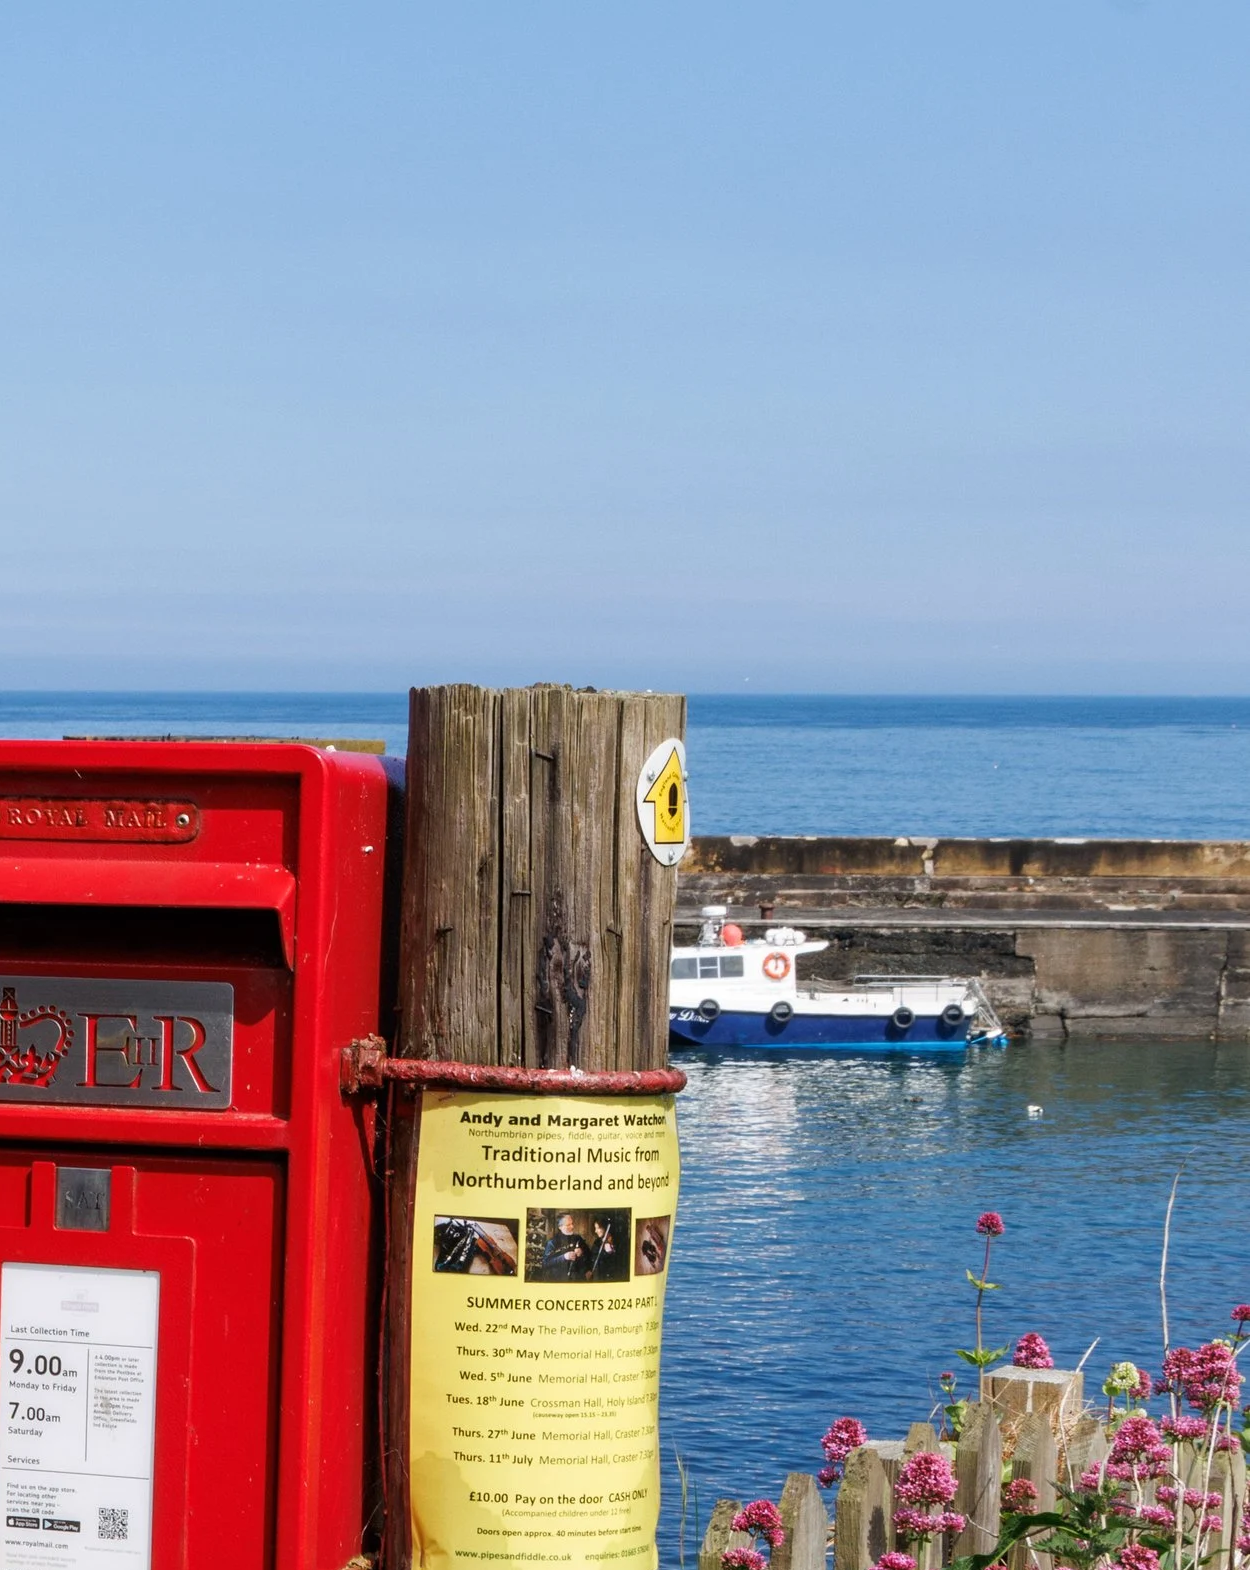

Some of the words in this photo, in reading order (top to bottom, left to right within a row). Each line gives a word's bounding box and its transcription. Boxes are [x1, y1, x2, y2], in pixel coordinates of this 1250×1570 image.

[7, 808, 89, 827] ROYAL
[105, 810, 166, 828] MAIL
[460, 1111, 503, 1128] Andy
[508, 1113, 541, 1126] and
[547, 1115, 619, 1129] Margaret
[468, 1129, 534, 1139] Northumbrian
[537, 1131, 565, 1141] pipes,
[568, 1130, 595, 1140] fiddle,
[597, 1131, 623, 1142] guitar,
[625, 1131, 643, 1139] voice
[643, 1131, 655, 1139] and
[482, 1145, 581, 1163] Traditional
[587, 1147, 631, 1163] Music
[635, 1147, 660, 1162] from
[452, 1171, 603, 1190] Northumberland
[608, 1173, 634, 1190] and
[638, 1170, 670, 1193] beyond
[65, 1190, 105, 1209] SAT
[467, 1296, 531, 1310] SUMMER
[536, 1299, 604, 1311] CONCERTS
[607, 1298, 633, 1310] 2024
[635, 1296, 654, 1309] PART
[10, 1324, 27, 1334] Last
[30, 1326, 68, 1336] Collection
[70, 1328, 90, 1338] Time
[455, 1321, 482, 1332] Wed.
[485, 1321, 508, 1333] 22nd
[511, 1325, 535, 1336] May
[538, 1325, 559, 1335] The
[560, 1325, 601, 1336] Pavilion,
[604, 1324, 643, 1336] Bamburgh
[456, 1346, 489, 1358] Thurs.
[492, 1347, 513, 1358] 30th
[516, 1350, 540, 1361] May
[543, 1350, 592, 1360] Memorial
[594, 1350, 615, 1361] Hall,
[616, 1348, 643, 1359] Craster
[9, 1349, 78, 1377] 9.00am
[459, 1370, 487, 1381] Wed.
[490, 1371, 505, 1382] 5th
[507, 1373, 532, 1383] June
[538, 1374, 588, 1384] Memorial
[590, 1374, 611, 1385] Hall,
[612, 1372, 639, 1383] Craster
[9, 1381, 39, 1392] Monday
[42, 1383, 50, 1391] to
[52, 1383, 77, 1394] Friday
[446, 1393, 473, 1405] Tues.
[476, 1395, 497, 1406] 18th
[499, 1397, 525, 1408] June
[530, 1398, 581, 1409] Crossman
[583, 1398, 604, 1409] Hall,
[607, 1396, 625, 1409] Holy
[626, 1394, 645, 1406] Island
[9, 1402, 61, 1423] 7.00am
[8, 1426, 43, 1438] Saturday
[452, 1427, 485, 1439] Thurs.
[488, 1428, 508, 1439] 27th
[511, 1430, 536, 1440] June
[542, 1430, 590, 1441] Memorial
[594, 1430, 613, 1442] Hall,
[615, 1429, 640, 1440] Craster
[7, 1455, 40, 1465] Services
[453, 1451, 486, 1463] Thurs.
[489, 1453, 510, 1464] 11th
[512, 1455, 533, 1466] July
[539, 1455, 588, 1465] Memorial
[591, 1455, 611, 1466] Hall,
[612, 1453, 639, 1464] Craster
[17, 1491, 40, 1500] locating
[469, 1491, 508, 1504] £10.00
[515, 1494, 536, 1507] Pay
[540, 1496, 554, 1504] on
[557, 1494, 576, 1504] the
[579, 1494, 603, 1504] door
[608, 1491, 630, 1503] CASH
[632, 1488, 649, 1501] ONLY
[502, 1509, 557, 1519] (Accompanied
[559, 1508, 588, 1517] children
[590, 1508, 609, 1517] under
[477, 1527, 500, 1536] Doors
[502, 1530, 522, 1538] open
[524, 1531, 554, 1540] approx.
[567, 1529, 597, 1537] minutes
[598, 1528, 618, 1536] before
[5, 1539, 69, 1550] www.royalmail.com
[455, 1549, 571, 1562] www.pipesandfiddle.co.uk
